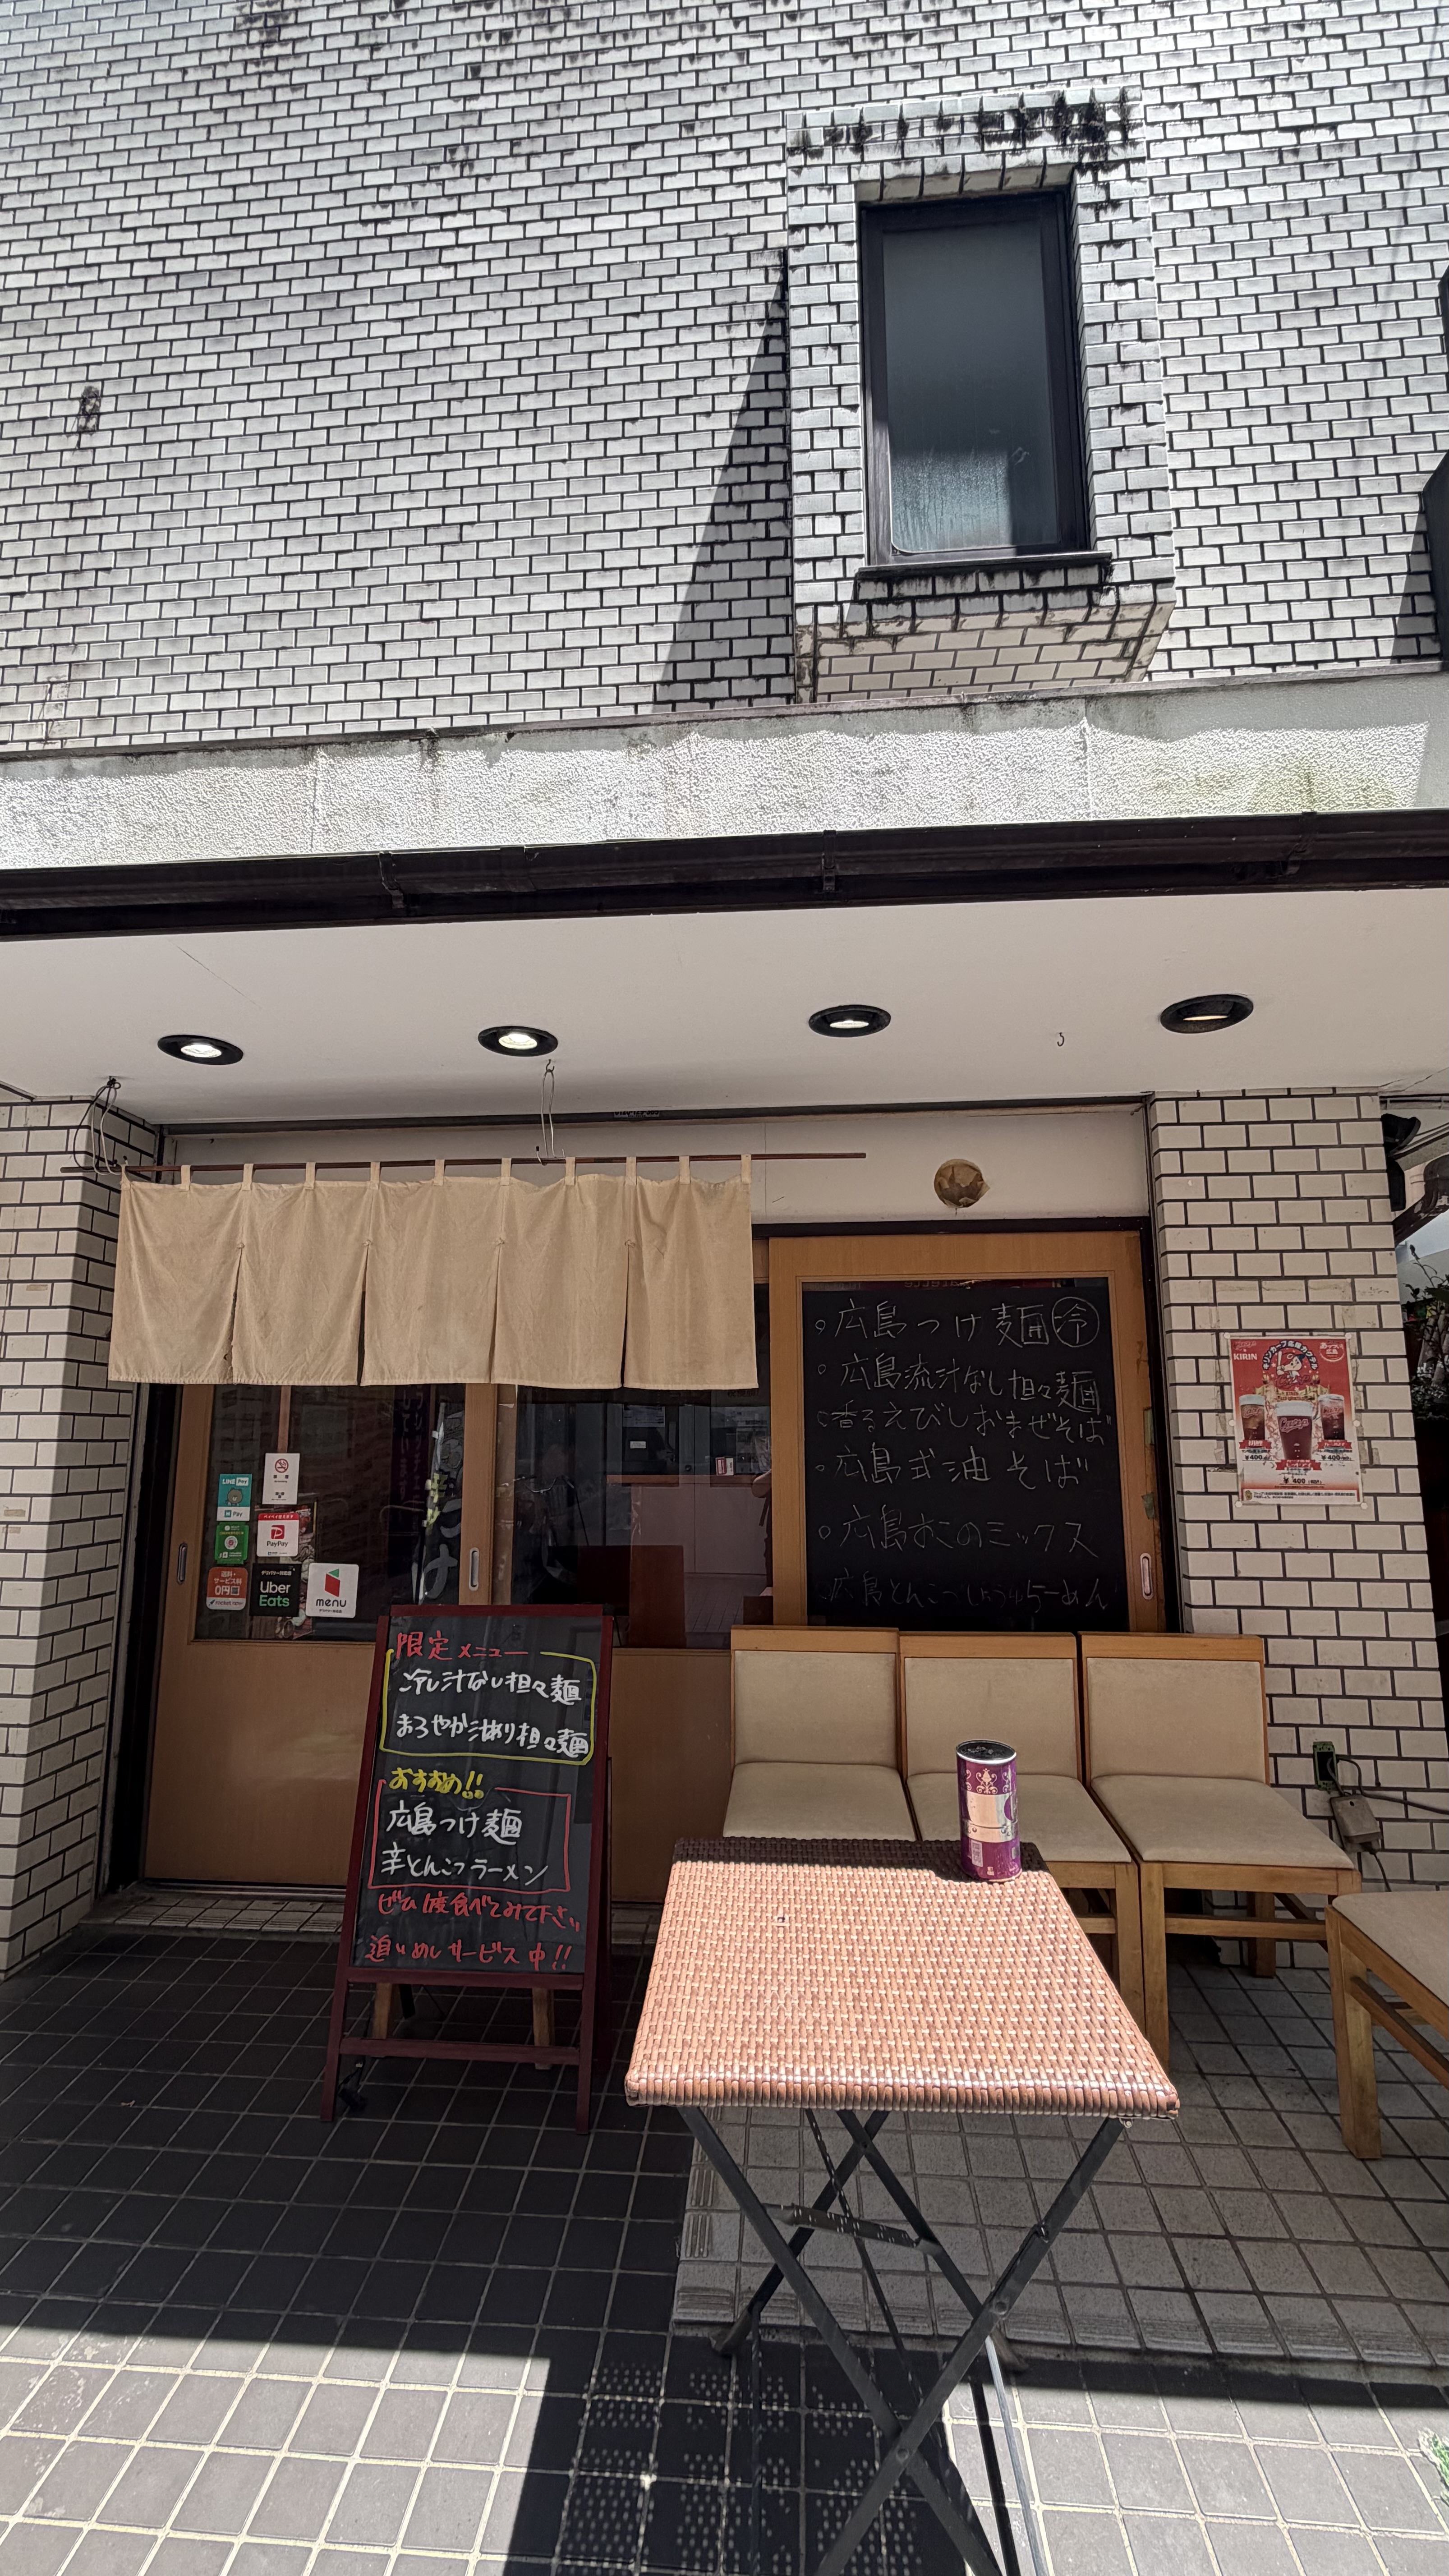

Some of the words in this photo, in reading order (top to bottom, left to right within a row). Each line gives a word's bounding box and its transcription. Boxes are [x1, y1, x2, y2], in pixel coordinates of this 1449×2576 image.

[1279, 1417, 1309, 1433] Carp
[260, 1581, 291, 1593] Uber
[259, 1594, 290, 1607] Eats
[316, 1599, 347, 1607] menu
[386, 1800, 522, 1845] 広島つけ麺
[381, 1842, 548, 1886] 辛とんこつラーメン
